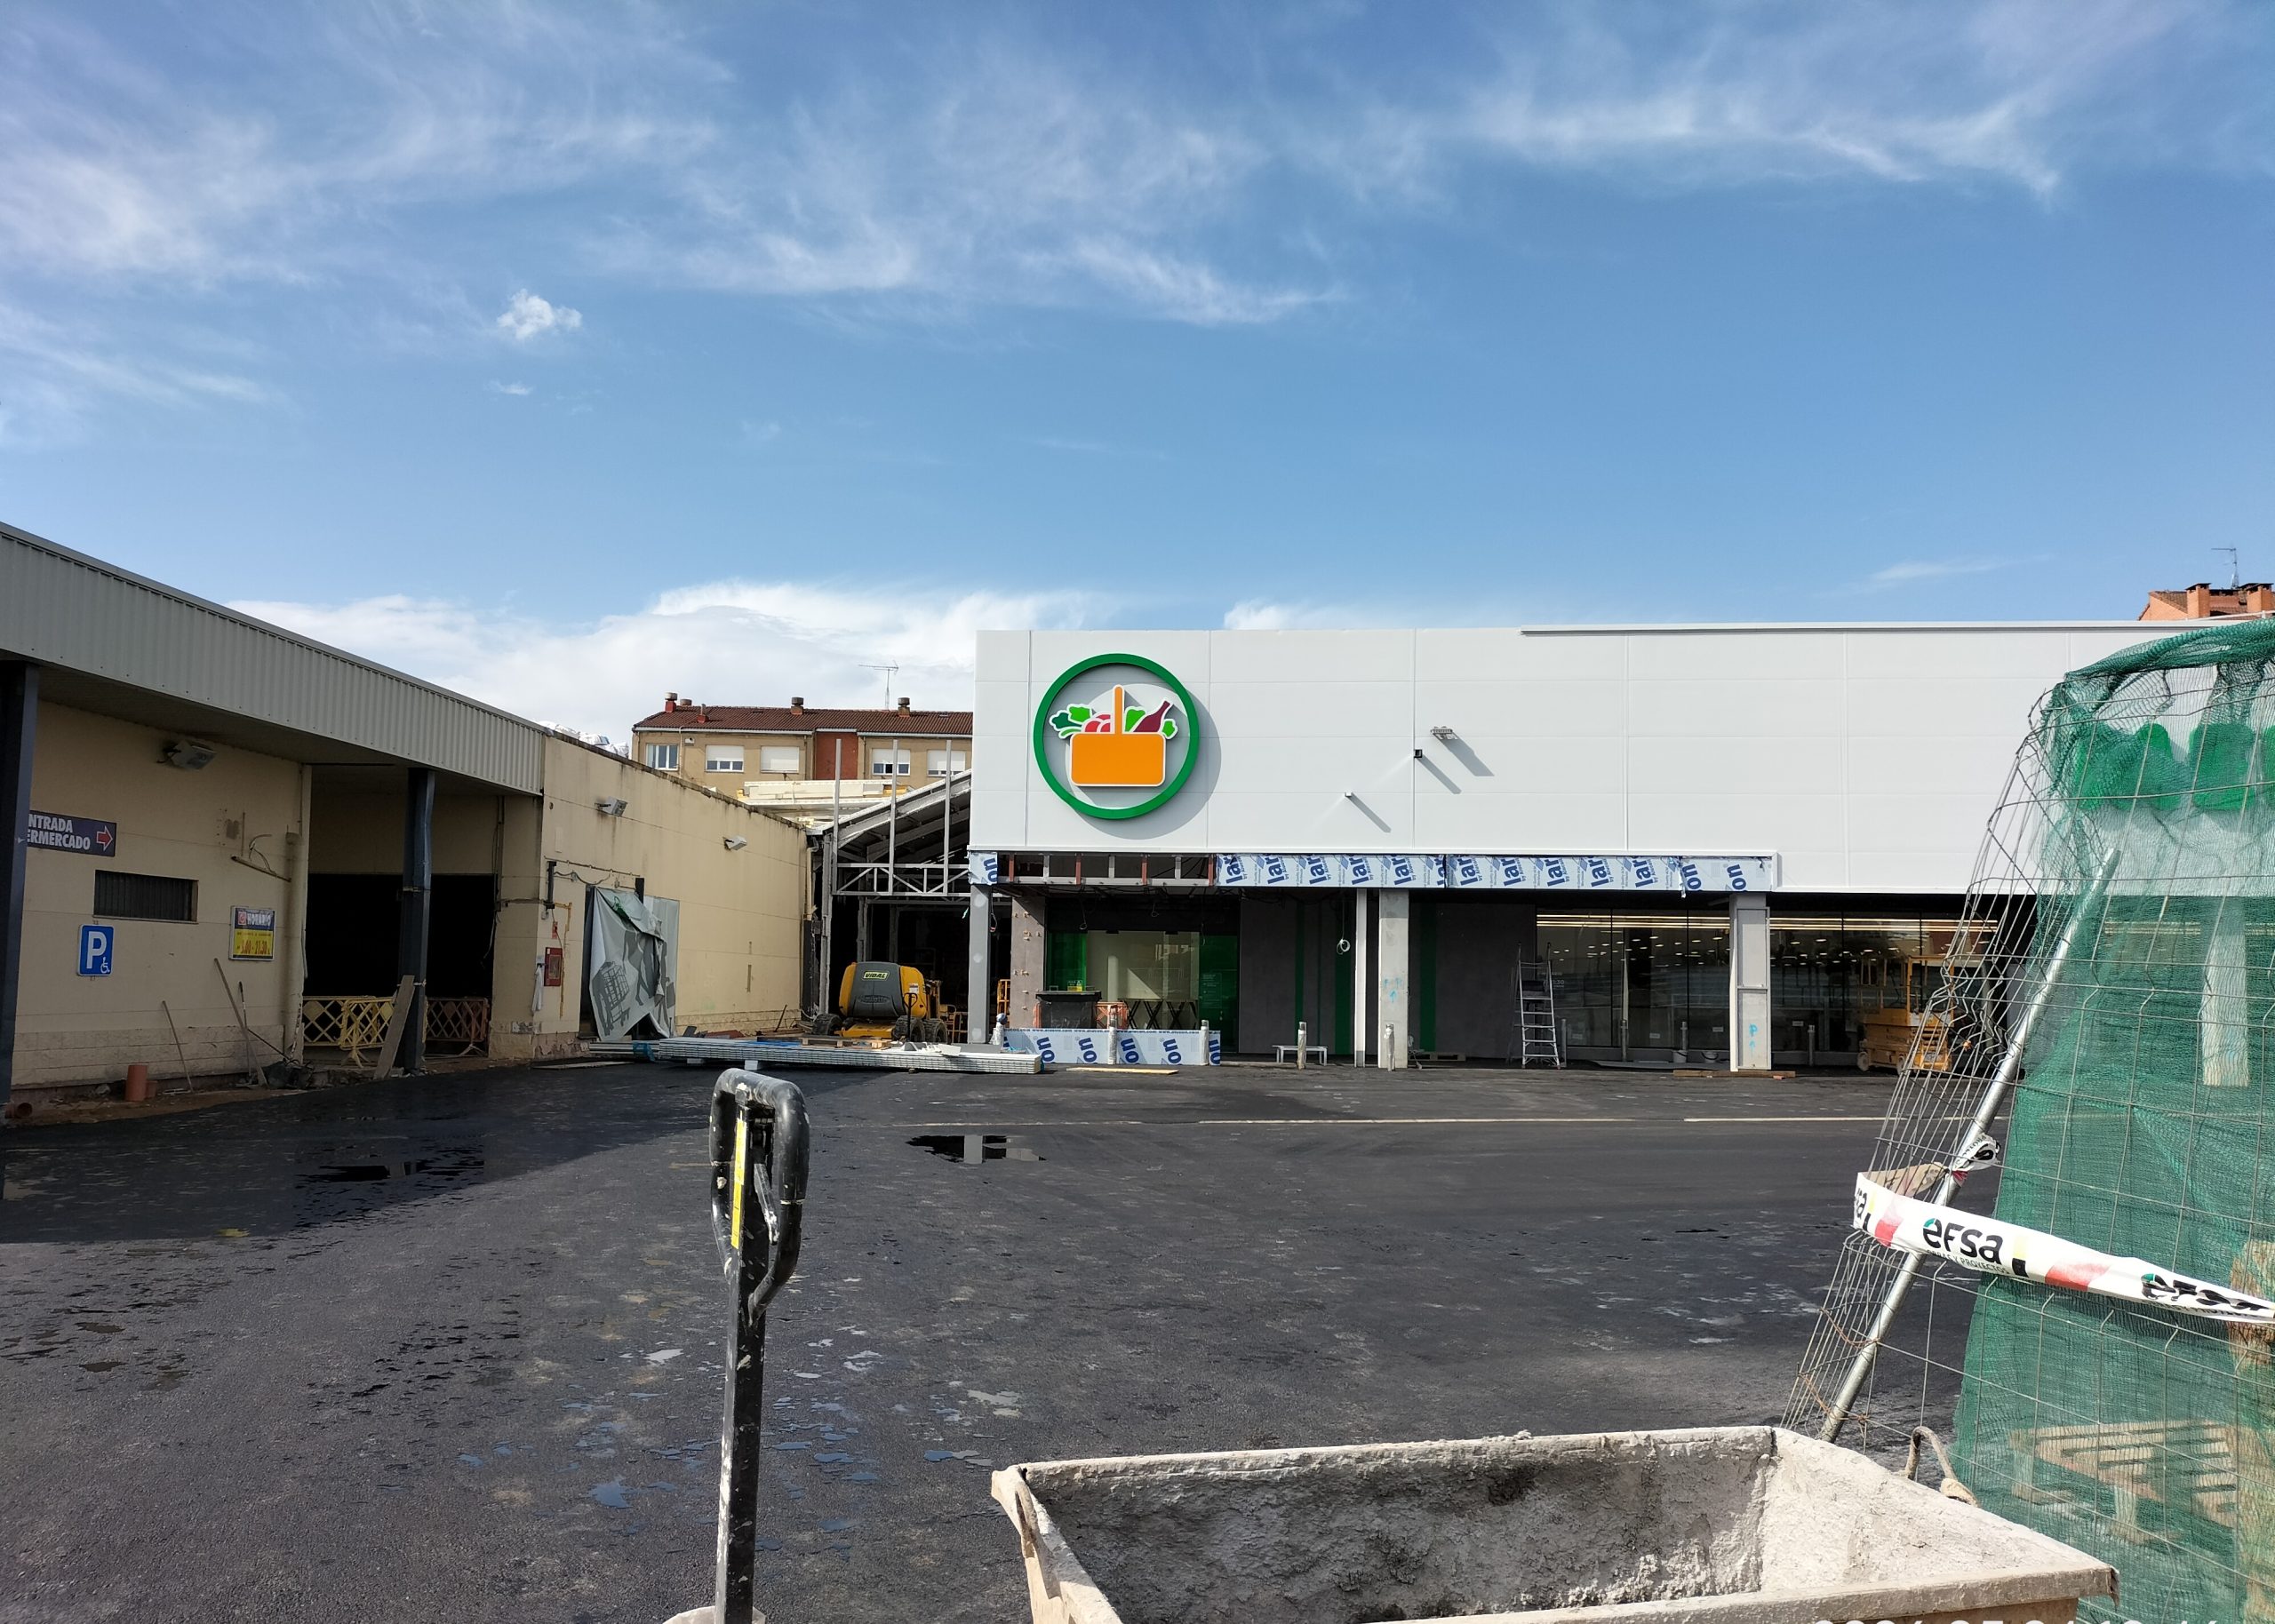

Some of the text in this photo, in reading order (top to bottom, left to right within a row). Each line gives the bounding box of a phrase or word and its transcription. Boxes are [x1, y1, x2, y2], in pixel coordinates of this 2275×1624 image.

[1265, 855, 1285, 884] lar
[1306, 855, 1328, 885] lar
[1349, 855, 1369, 885] lar
[1392, 855, 1412, 886] lar
[1545, 857, 1566, 887] lar
[1588, 856, 1609, 888] lar
[1632, 856, 1654, 888] lar
[1727, 864, 1747, 890] on
[87, 930, 107, 969] P
[1036, 1037, 1055, 1062] on
[1078, 1038, 1097, 1063] on
[1121, 1038, 1139, 1063] on
[1162, 1039, 1182, 1063] on
